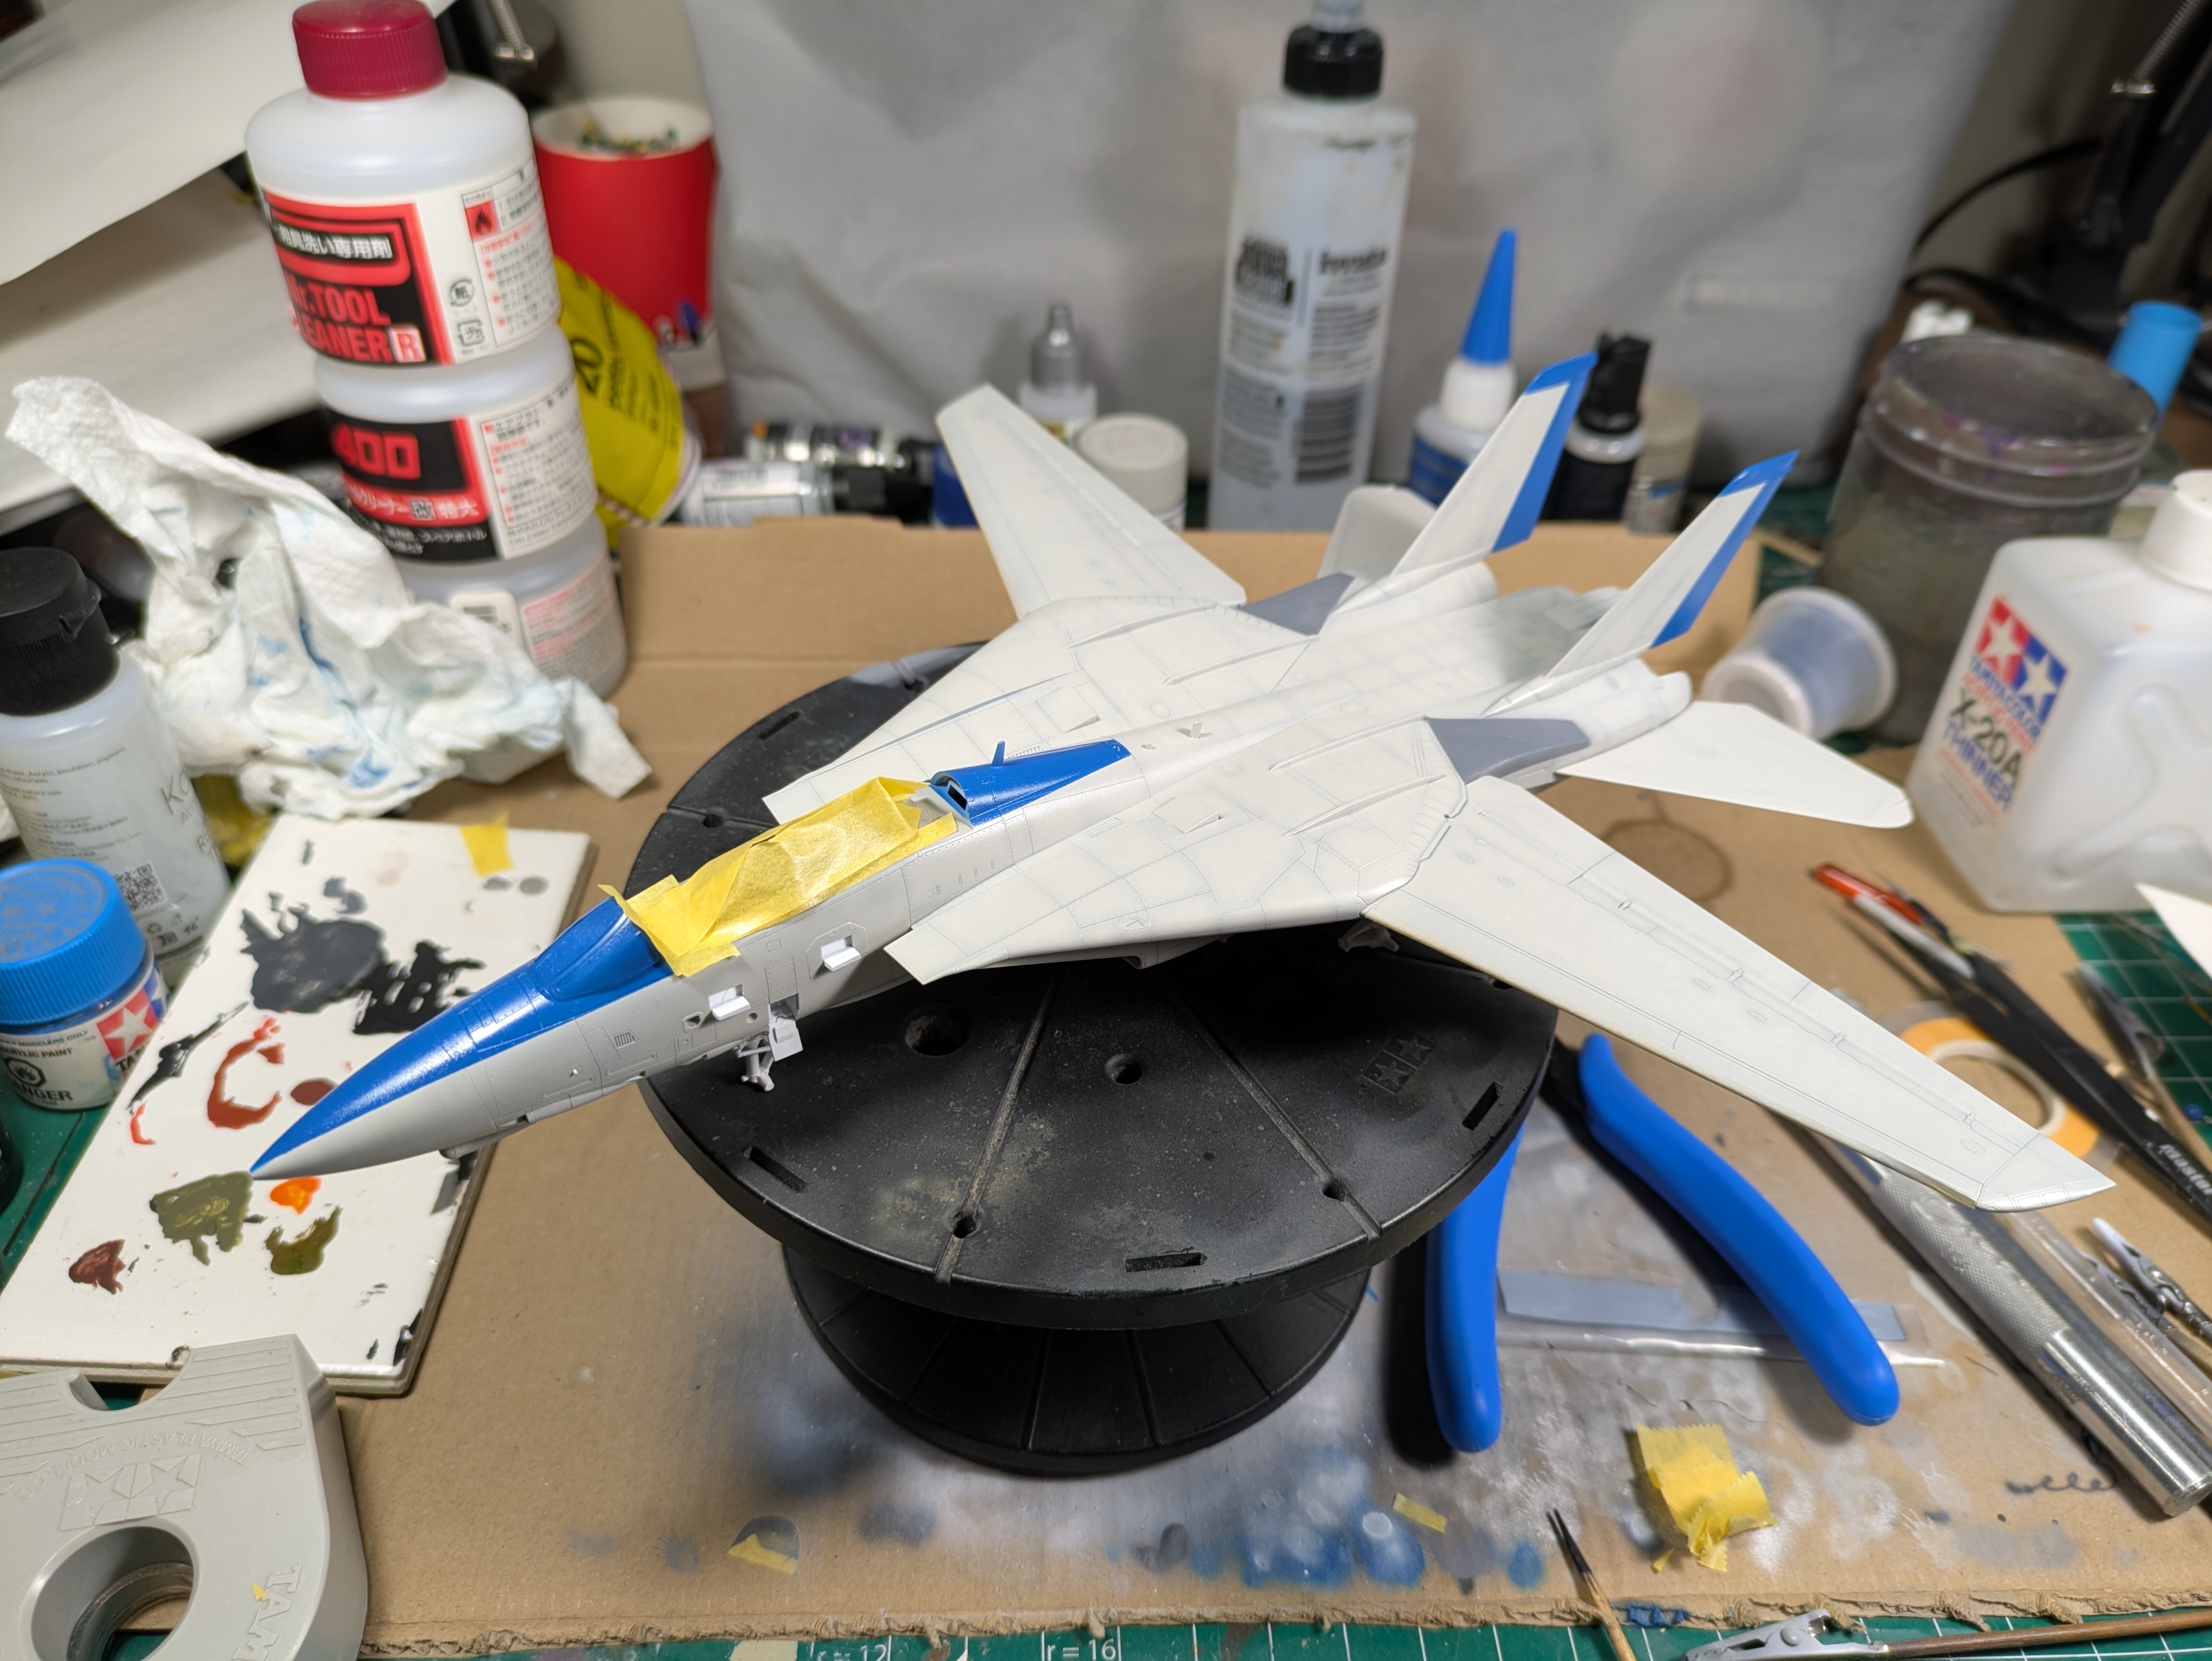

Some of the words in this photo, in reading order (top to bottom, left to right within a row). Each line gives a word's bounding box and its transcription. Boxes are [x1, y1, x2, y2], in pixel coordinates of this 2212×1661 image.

[1949, 687, 2022, 791] X-20A
[1943, 717, 2013, 812] THINNER
[41, 1048, 73, 1058] PAINT
[122, 1429, 197, 1451] PLASTIC
[200, 1433, 251, 1466] TAMIYA
[47, 1443, 116, 1477] MODEL
[1088, 1638, 1117, 1660] 16
